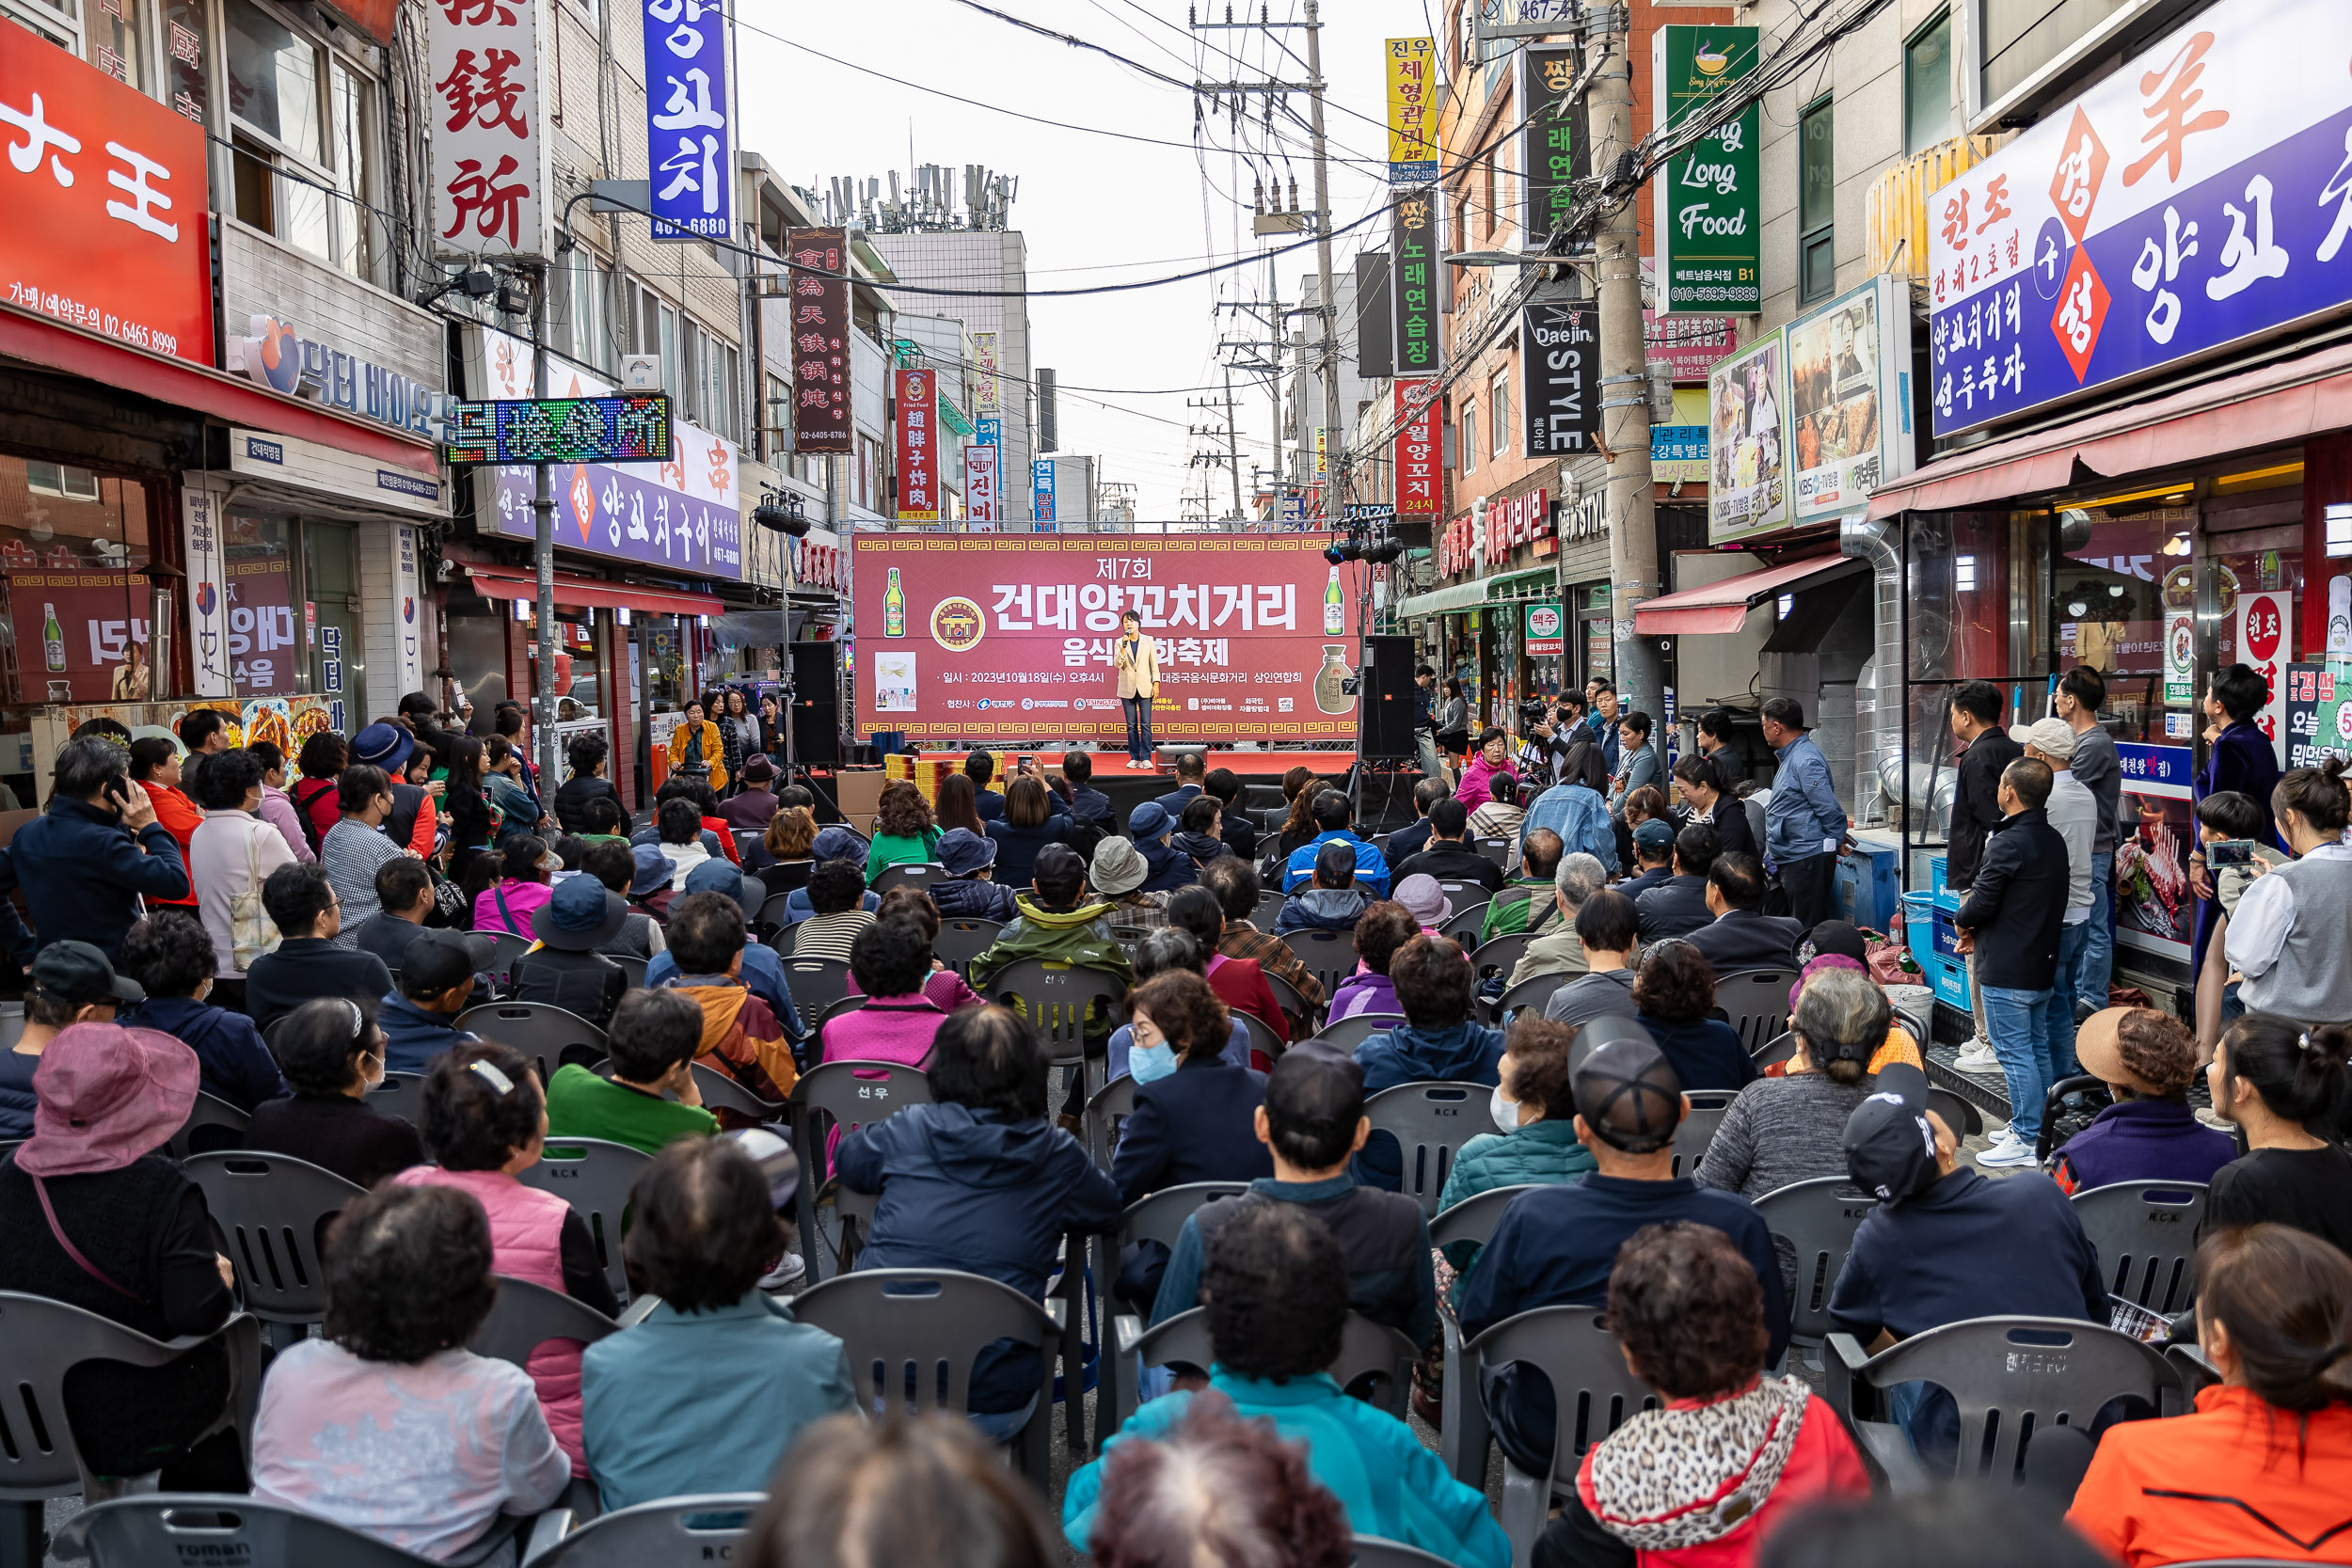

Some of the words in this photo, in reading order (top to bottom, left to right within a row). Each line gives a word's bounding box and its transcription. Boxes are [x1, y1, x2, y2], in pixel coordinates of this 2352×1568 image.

[1391, 40, 1430, 57] 진우
[1397, 61, 1426, 148] 체형관리
[1405, 150, 1422, 160] 2F
[1680, 153, 1738, 196] Long
[1400, 199, 1428, 230] 짱
[1679, 202, 1747, 240] Food
[1942, 173, 2011, 250] 원조
[656, 217, 725, 234] 467-6880
[1676, 269, 1732, 281] 베트남음식점
[1738, 268, 1755, 281] B1
[1403, 240, 1429, 364] 노래연습장
[1671, 286, 1758, 302] 010-5696-9889
[104, 314, 119, 337] 02
[122, 321, 149, 347] 6465
[152, 330, 177, 356] 8999
[976, 335, 995, 347] 홍콩
[1537, 326, 1590, 344] Daejin
[303, 339, 358, 414] 닥터
[979, 347, 994, 403] 노래연습장
[1548, 351, 1582, 451] STYLE
[1534, 417, 1545, 451] 헤어샵
[251, 441, 280, 460] 건대직영점
[907, 410, 927, 506] 趙胖子炸肉
[1406, 499, 1433, 510] 24시
[603, 475, 711, 564] 양꼬치구이
[1096, 558, 1152, 580] 제7회
[992, 583, 1296, 632] 건대양꼬치거리
[1532, 613, 1557, 626] 맥주
[2248, 611, 2278, 642] 원조
[405, 635, 416, 682] Dr.
[1062, 638, 1229, 667] 음식화축제
[1528, 641, 1562, 651] 해월양꼬치
[199, 629, 217, 689] Dr.
[322, 626, 342, 693] 닥터
[943, 673, 962, 684] 일시
[971, 672, 1066, 684] 2023년10월18일(수)
[1069, 672, 1104, 684] 오후4시
[1253, 673, 1302, 684] 상인연합회
[2299, 672, 2335, 702] 경성
[946, 699, 970, 709] 협찬사
[2291, 711, 2320, 736] 오늘
[1941, 975, 1962, 994] 하이트진로
[858, 1086, 889, 1101] 선우
[1434, 1108, 1457, 1117] R.C.K
[551, 1169, 579, 1179] R.C.K
[177, 1542, 250, 1557] roman
